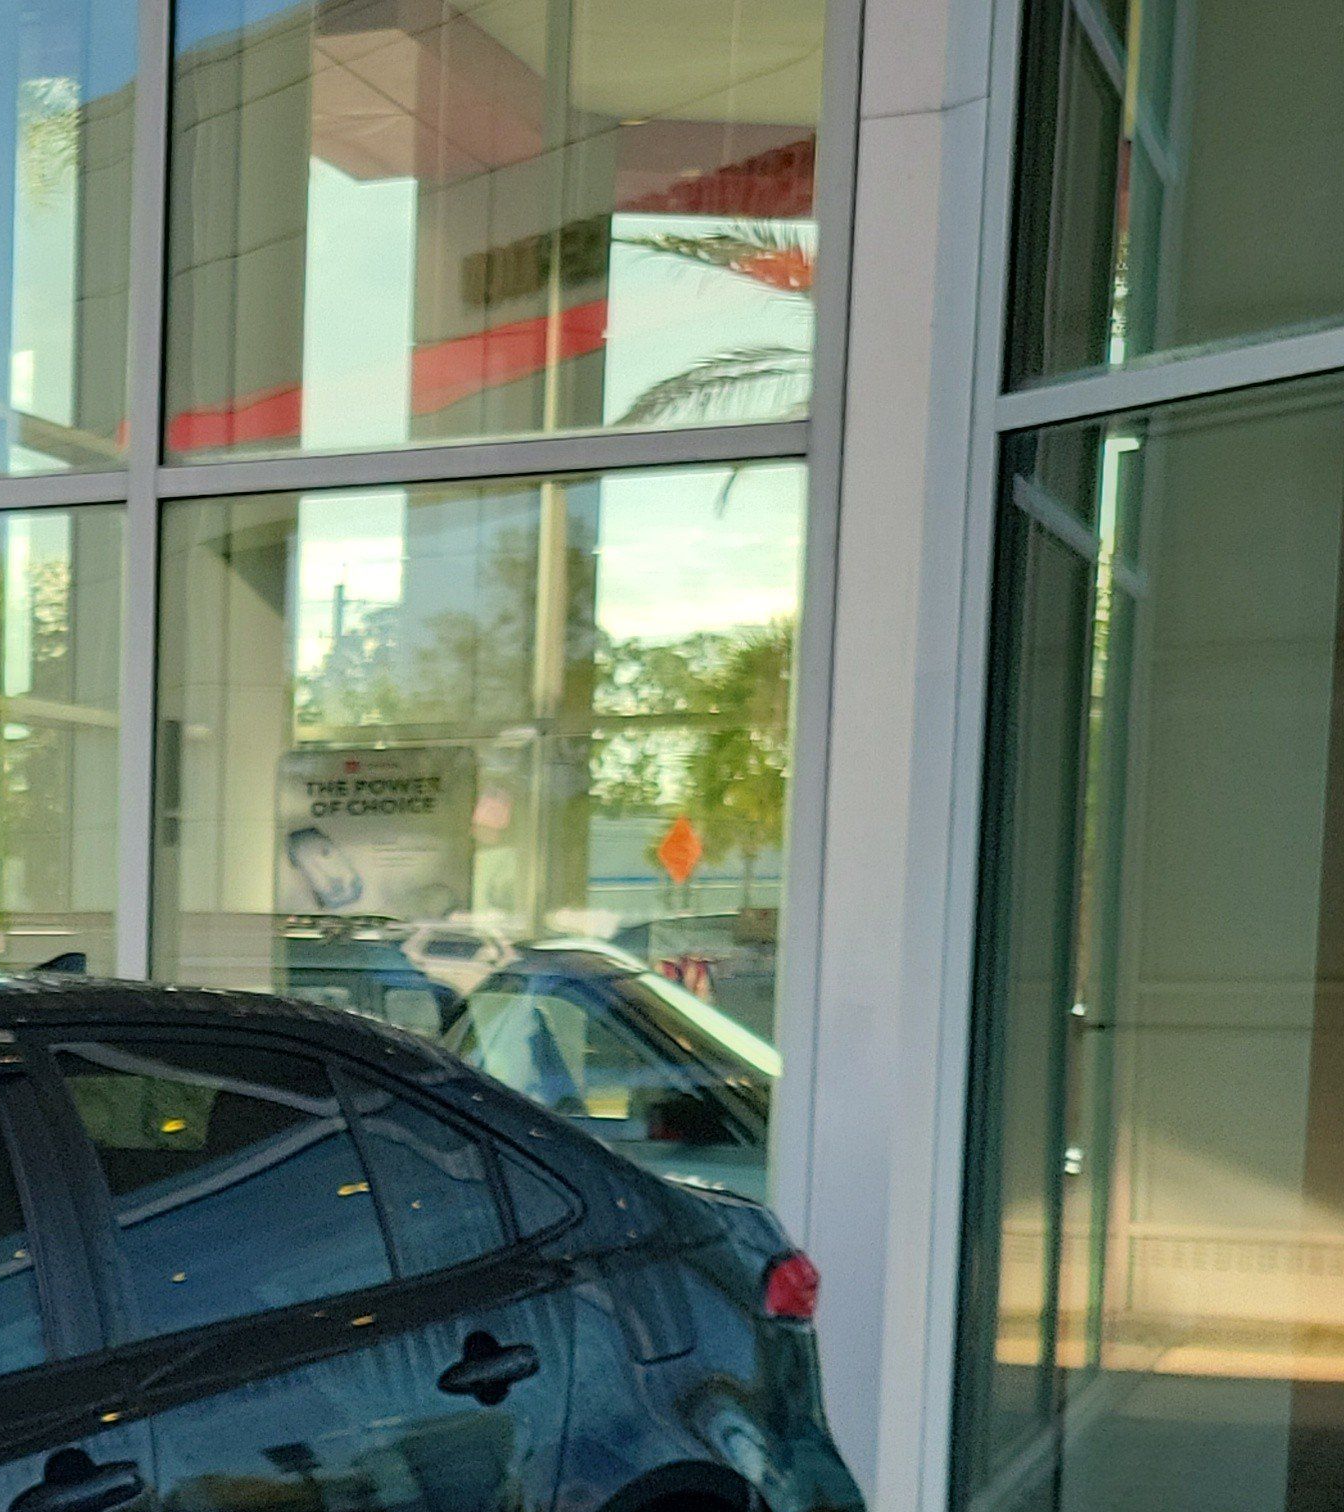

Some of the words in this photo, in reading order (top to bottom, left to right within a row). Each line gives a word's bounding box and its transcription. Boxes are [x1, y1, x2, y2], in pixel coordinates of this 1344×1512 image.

[306, 780, 348, 797] THE
[311, 800, 343, 817] OF
[346, 796, 435, 816] CHOICE
